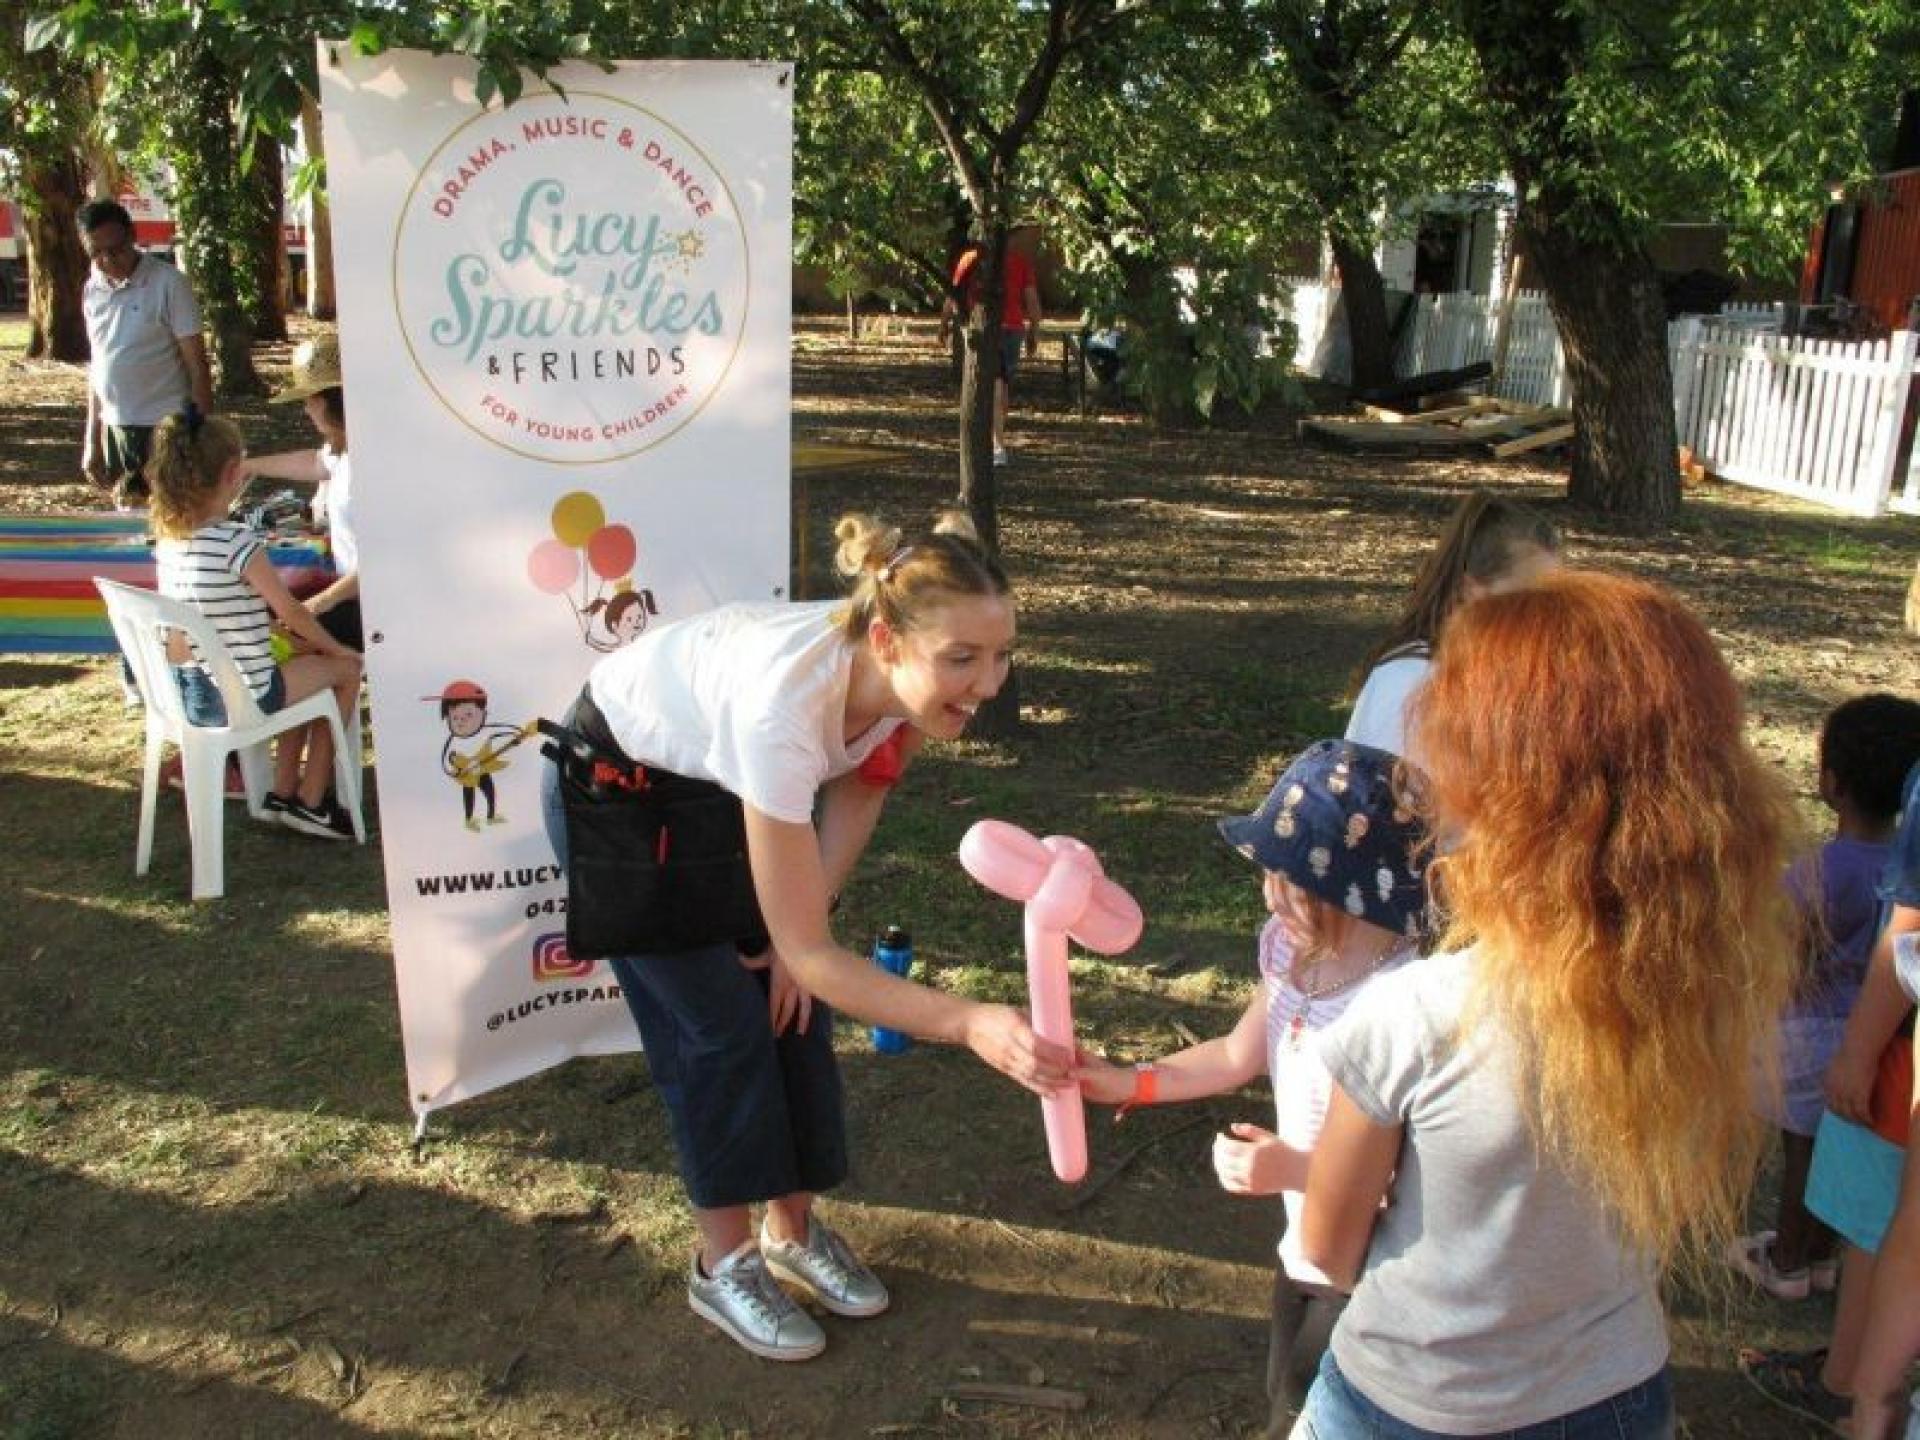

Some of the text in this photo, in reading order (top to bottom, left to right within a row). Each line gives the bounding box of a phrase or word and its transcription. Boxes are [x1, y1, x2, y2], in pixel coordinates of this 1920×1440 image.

[522, 116, 608, 143] MUSIC
[616, 127, 635, 150] &
[642, 140, 714, 219] DANCE
[501, 178, 662, 291] Lucy
[430, 253, 725, 364] Sparkles
[487, 344, 687, 385] & FRIENDS
[479, 382, 690, 442] FOR YOUNG CHILDREN
[415, 863, 563, 897] WWW.LUCY
